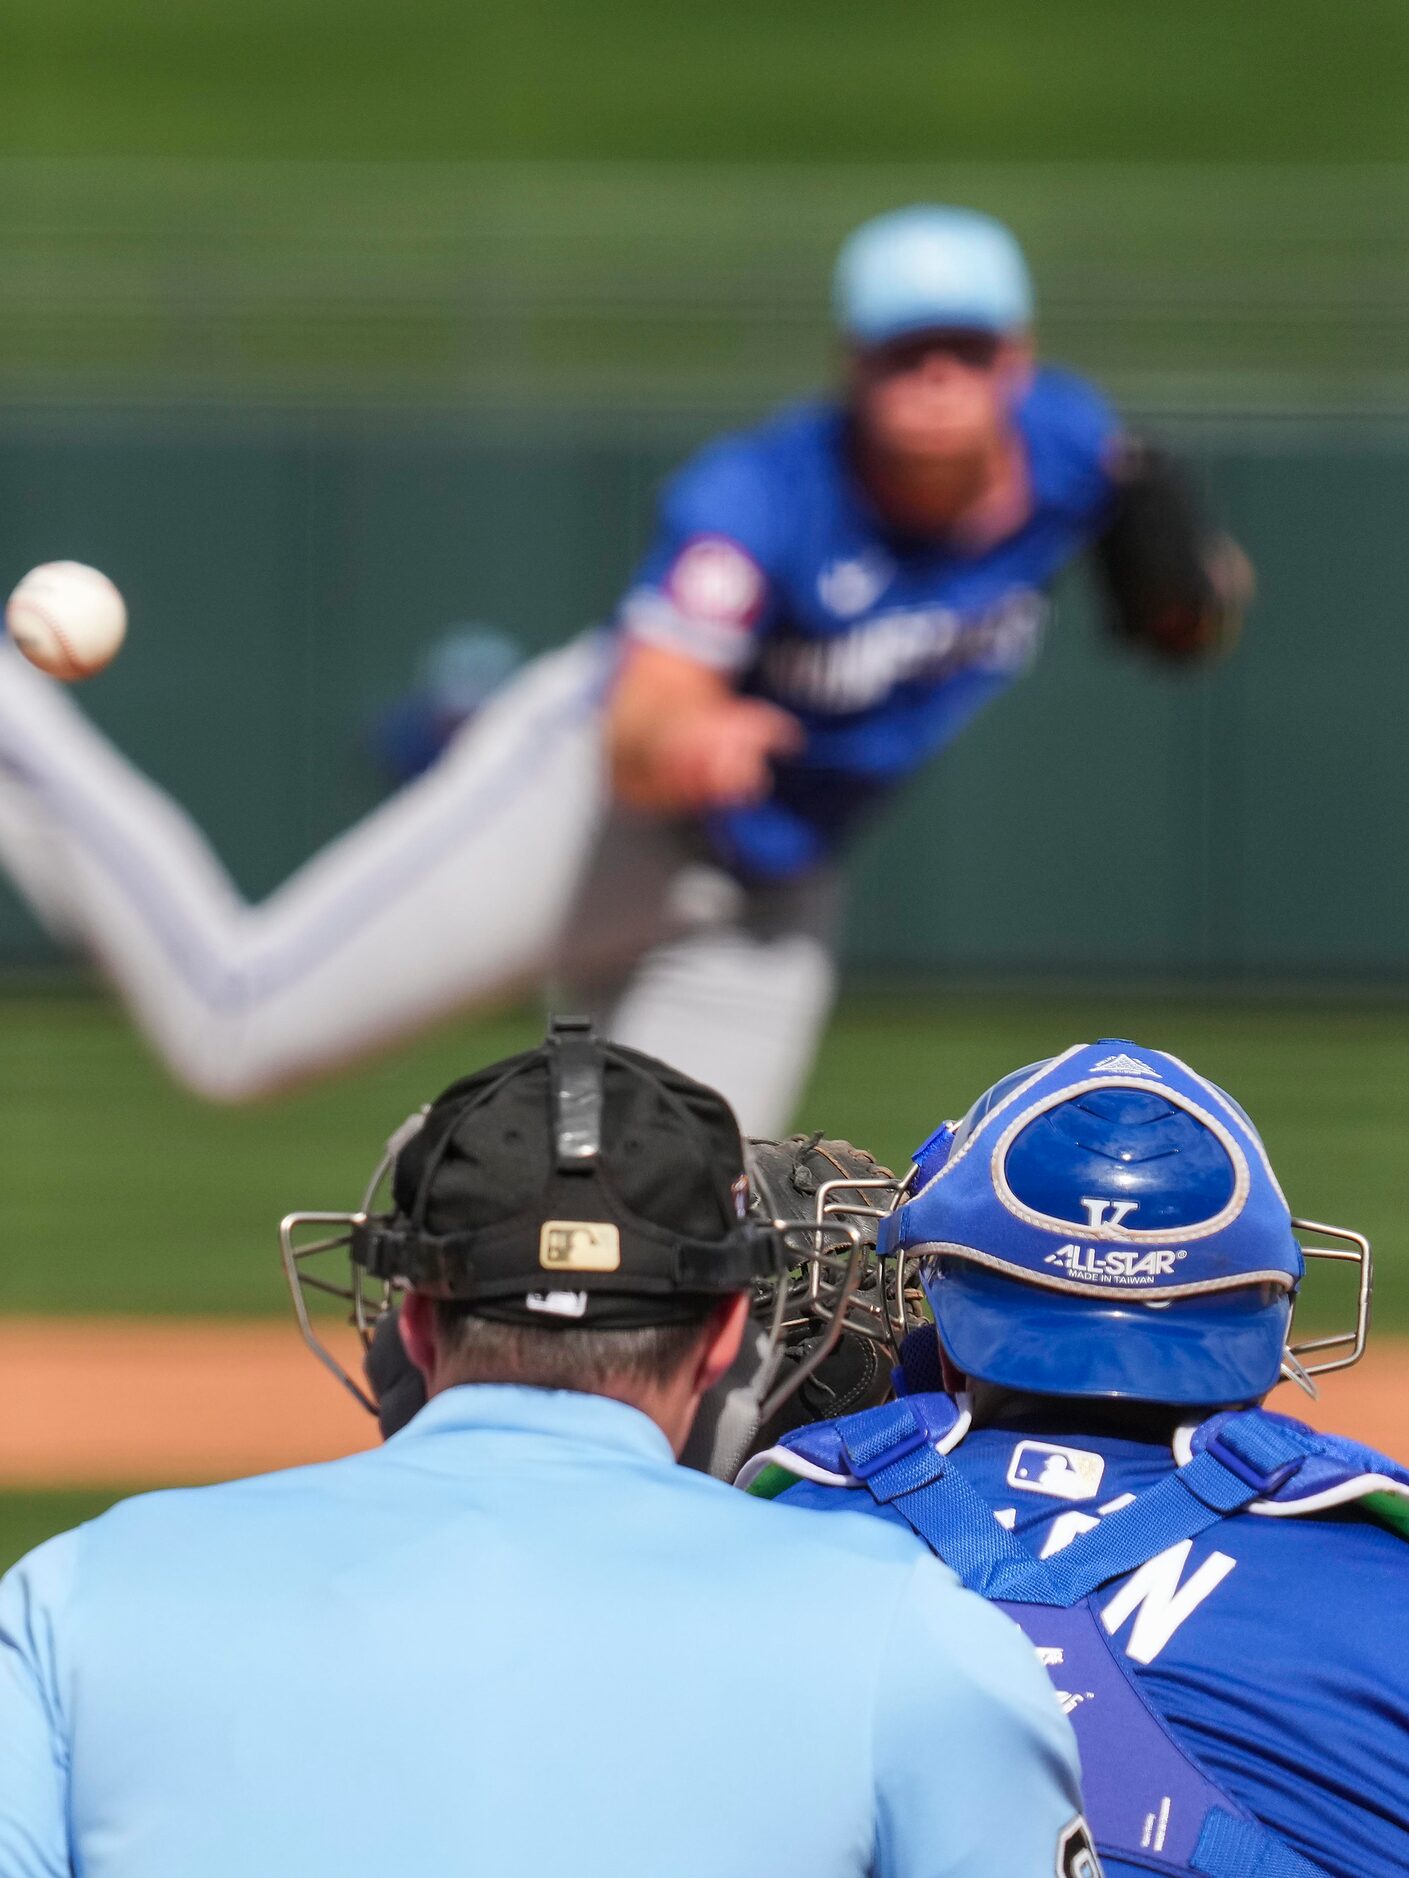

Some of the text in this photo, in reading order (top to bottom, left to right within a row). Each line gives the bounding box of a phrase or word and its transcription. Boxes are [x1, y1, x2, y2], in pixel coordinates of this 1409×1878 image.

[1068, 1268, 1155, 1284] MADE IN TAIWAN
